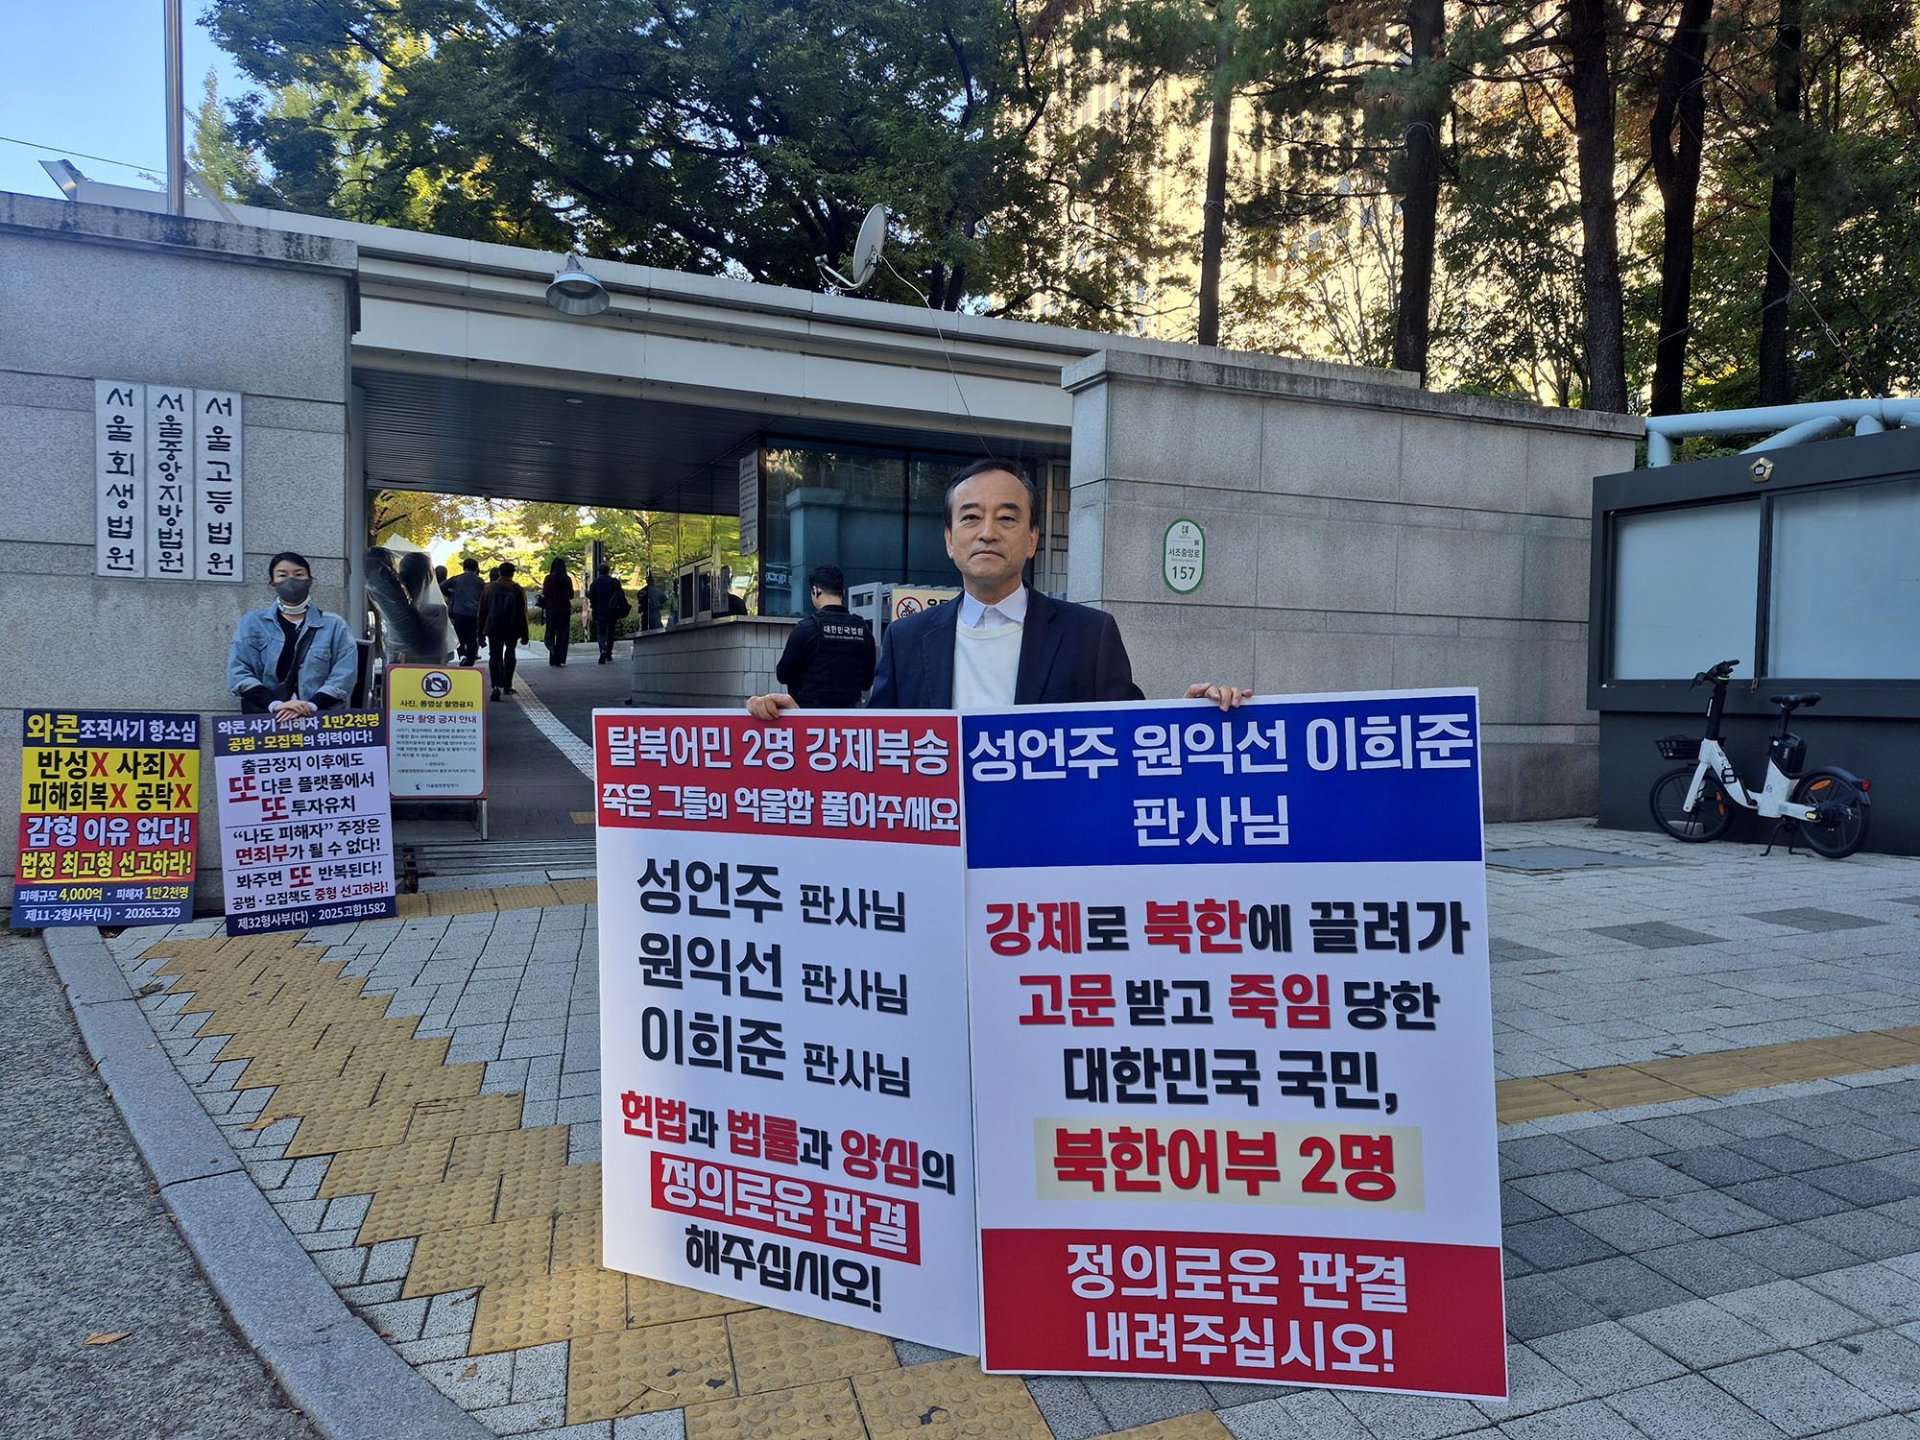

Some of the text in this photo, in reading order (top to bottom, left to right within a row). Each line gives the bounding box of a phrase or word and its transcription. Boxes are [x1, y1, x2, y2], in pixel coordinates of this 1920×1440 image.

[106, 387, 135, 572] 서울회생법원
[157, 393, 184, 574] 서울중앙지방법원
[206, 397, 234, 577] 서울고등법원
[1172, 566, 1195, 580] 157
[149, 719, 196, 743] 항소심
[218, 721, 246, 735] 와콘
[250, 718, 276, 733] 사기
[322, 713, 380, 729] 1만2천명
[317, 730, 373, 746] 위력이다!
[396, 714, 415, 724] 무단
[438, 714, 457, 724] 금지
[459, 715, 477, 724] 안내
[241, 753, 364, 775] 출금정지 이후에도
[607, 725, 949, 776] 탈북어민 2명 강제북송
[968, 713, 1474, 782] 성언주 원익선 이희준
[229, 772, 375, 804] 또 다른 플랫폼에서
[261, 796, 356, 822] 또 투자유치
[602, 783, 959, 831] 죽은 그들의 억울함 풀어주세요
[27, 815, 191, 847] 감형 이유 없다!
[337, 818, 381, 836] 주장은
[1132, 795, 1290, 848] 판사님
[21, 851, 192, 879] 법정 최고형 선고하라!
[236, 838, 380, 866] 면죄부가 될 수 없다!
[237, 861, 382, 889] 봐주면 또 반복된다!
[19, 886, 189, 903] 피해규모 4,000억 피해자 1만2천명
[238, 903, 386, 930] 제32형사부(다) 2025고합1582
[314, 887, 337, 901] 중형
[341, 881, 389, 897] 선고하라!
[637, 858, 906, 933] 성언주 판사님
[986, 898, 1471, 956] 강제로 북한에 끌려가
[638, 932, 907, 1016] 원익선 판사님
[1018, 974, 1440, 1031] 고문 받고 죽임 당한
[641, 1006, 911, 1098] 이희준 판사님
[1062, 1046, 1398, 1115] 대한민국 국민,
[621, 1090, 955, 1195] 헌법과 법률과 양심의
[1054, 1127, 1397, 1202] 북한어부 2명
[660, 1158, 908, 1256] 정의로운 판결
[685, 1224, 882, 1313] 해주십시오!
[1067, 1243, 1409, 1315] 정의로운 판결
[1085, 1311, 1395, 1374] 내려주십시오!
